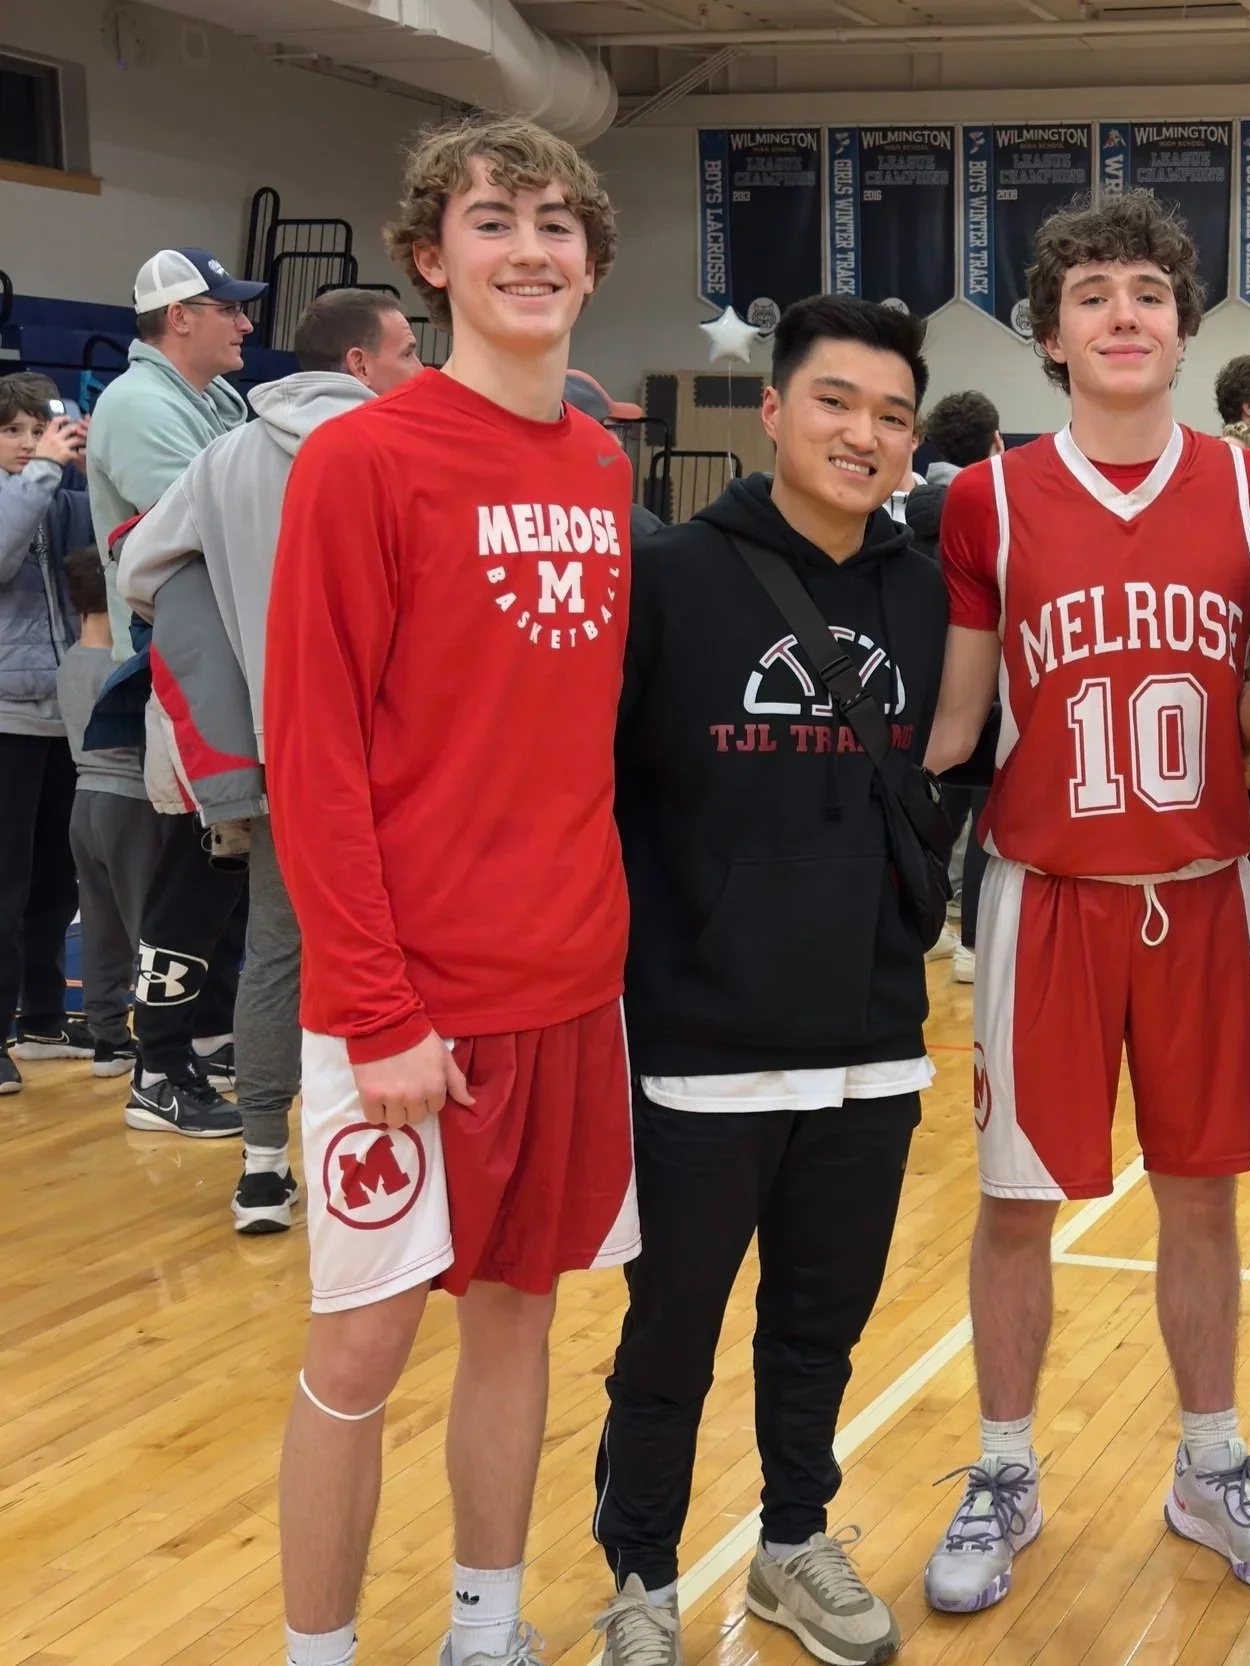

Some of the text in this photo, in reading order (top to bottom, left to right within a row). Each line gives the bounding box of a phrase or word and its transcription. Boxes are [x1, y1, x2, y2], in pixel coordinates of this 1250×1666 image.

[731, 132, 817, 151] WILMINGTON
[861, 131, 951, 150] WILMINGTON
[996, 128, 1088, 148] WILMINGTON
[1134, 126, 1228, 146] WILMINGTON
[704, 160, 726, 294] BOYS LACROSSE
[834, 159, 856, 295] GIRLS WINTER TRACK
[969, 160, 988, 294] BOYS WINTER TRACK
[477, 503, 621, 556] MELROSE
[486, 566, 620, 649] BASKETBALL
[538, 560, 585, 614] M
[1019, 582, 1244, 688] MELROSE
[709, 724, 777, 752] TJL
[1066, 672, 1208, 818] 10
[338, 1134, 412, 1210] M
